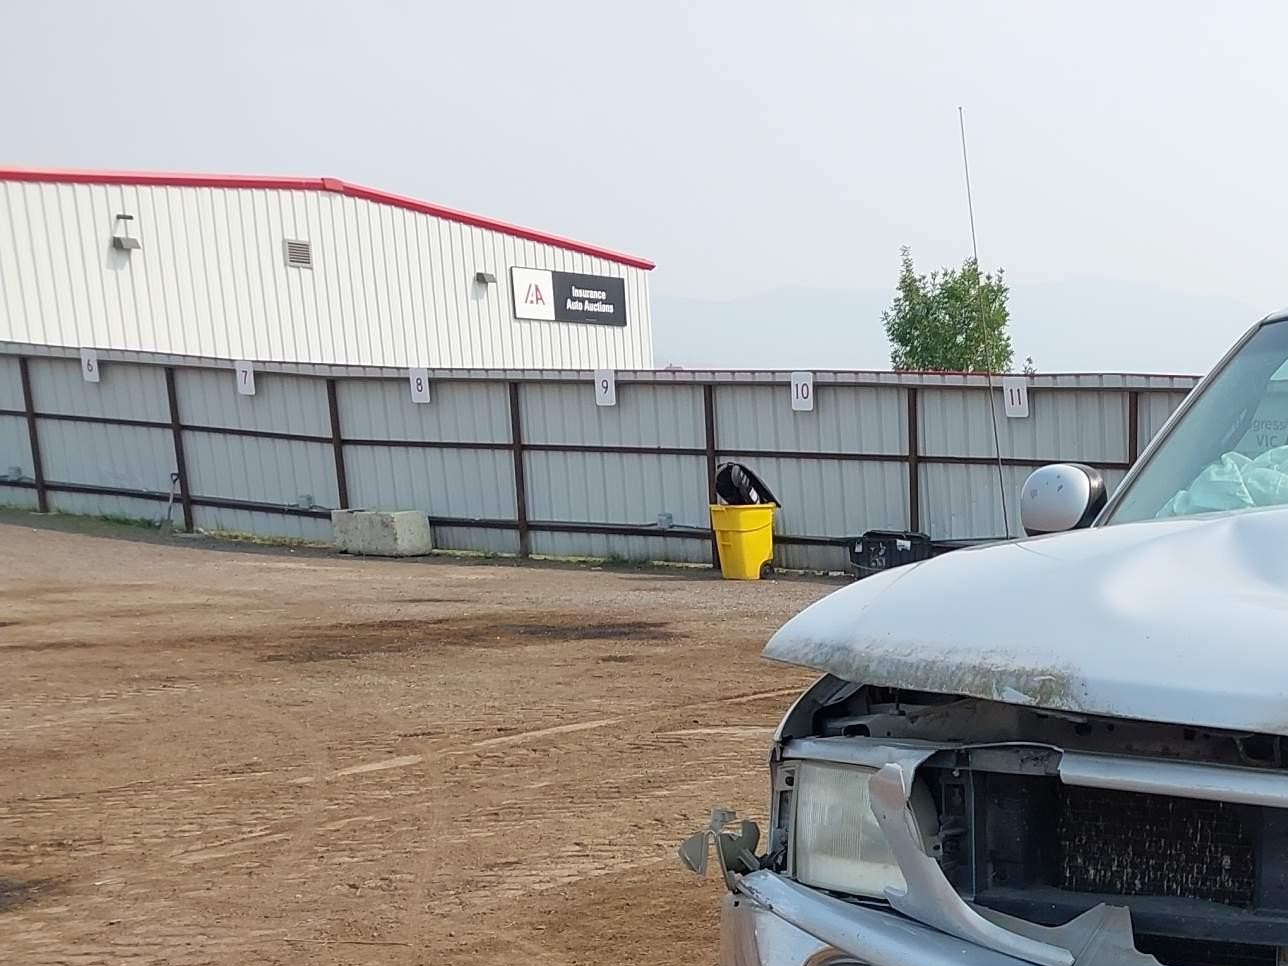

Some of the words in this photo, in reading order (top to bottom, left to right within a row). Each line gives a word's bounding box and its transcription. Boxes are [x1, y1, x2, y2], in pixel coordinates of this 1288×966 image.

[571, 286, 606, 300] Insurance
[566, 298, 583, 311] Auto
[584, 299, 614, 313] Auctions
[86, 359, 93, 373] 6
[241, 370, 248, 385] 7
[415, 377, 423, 393] 8
[601, 379, 609, 394] 9
[795, 383, 810, 400] 10
[1009, 388, 1022, 406] 11
